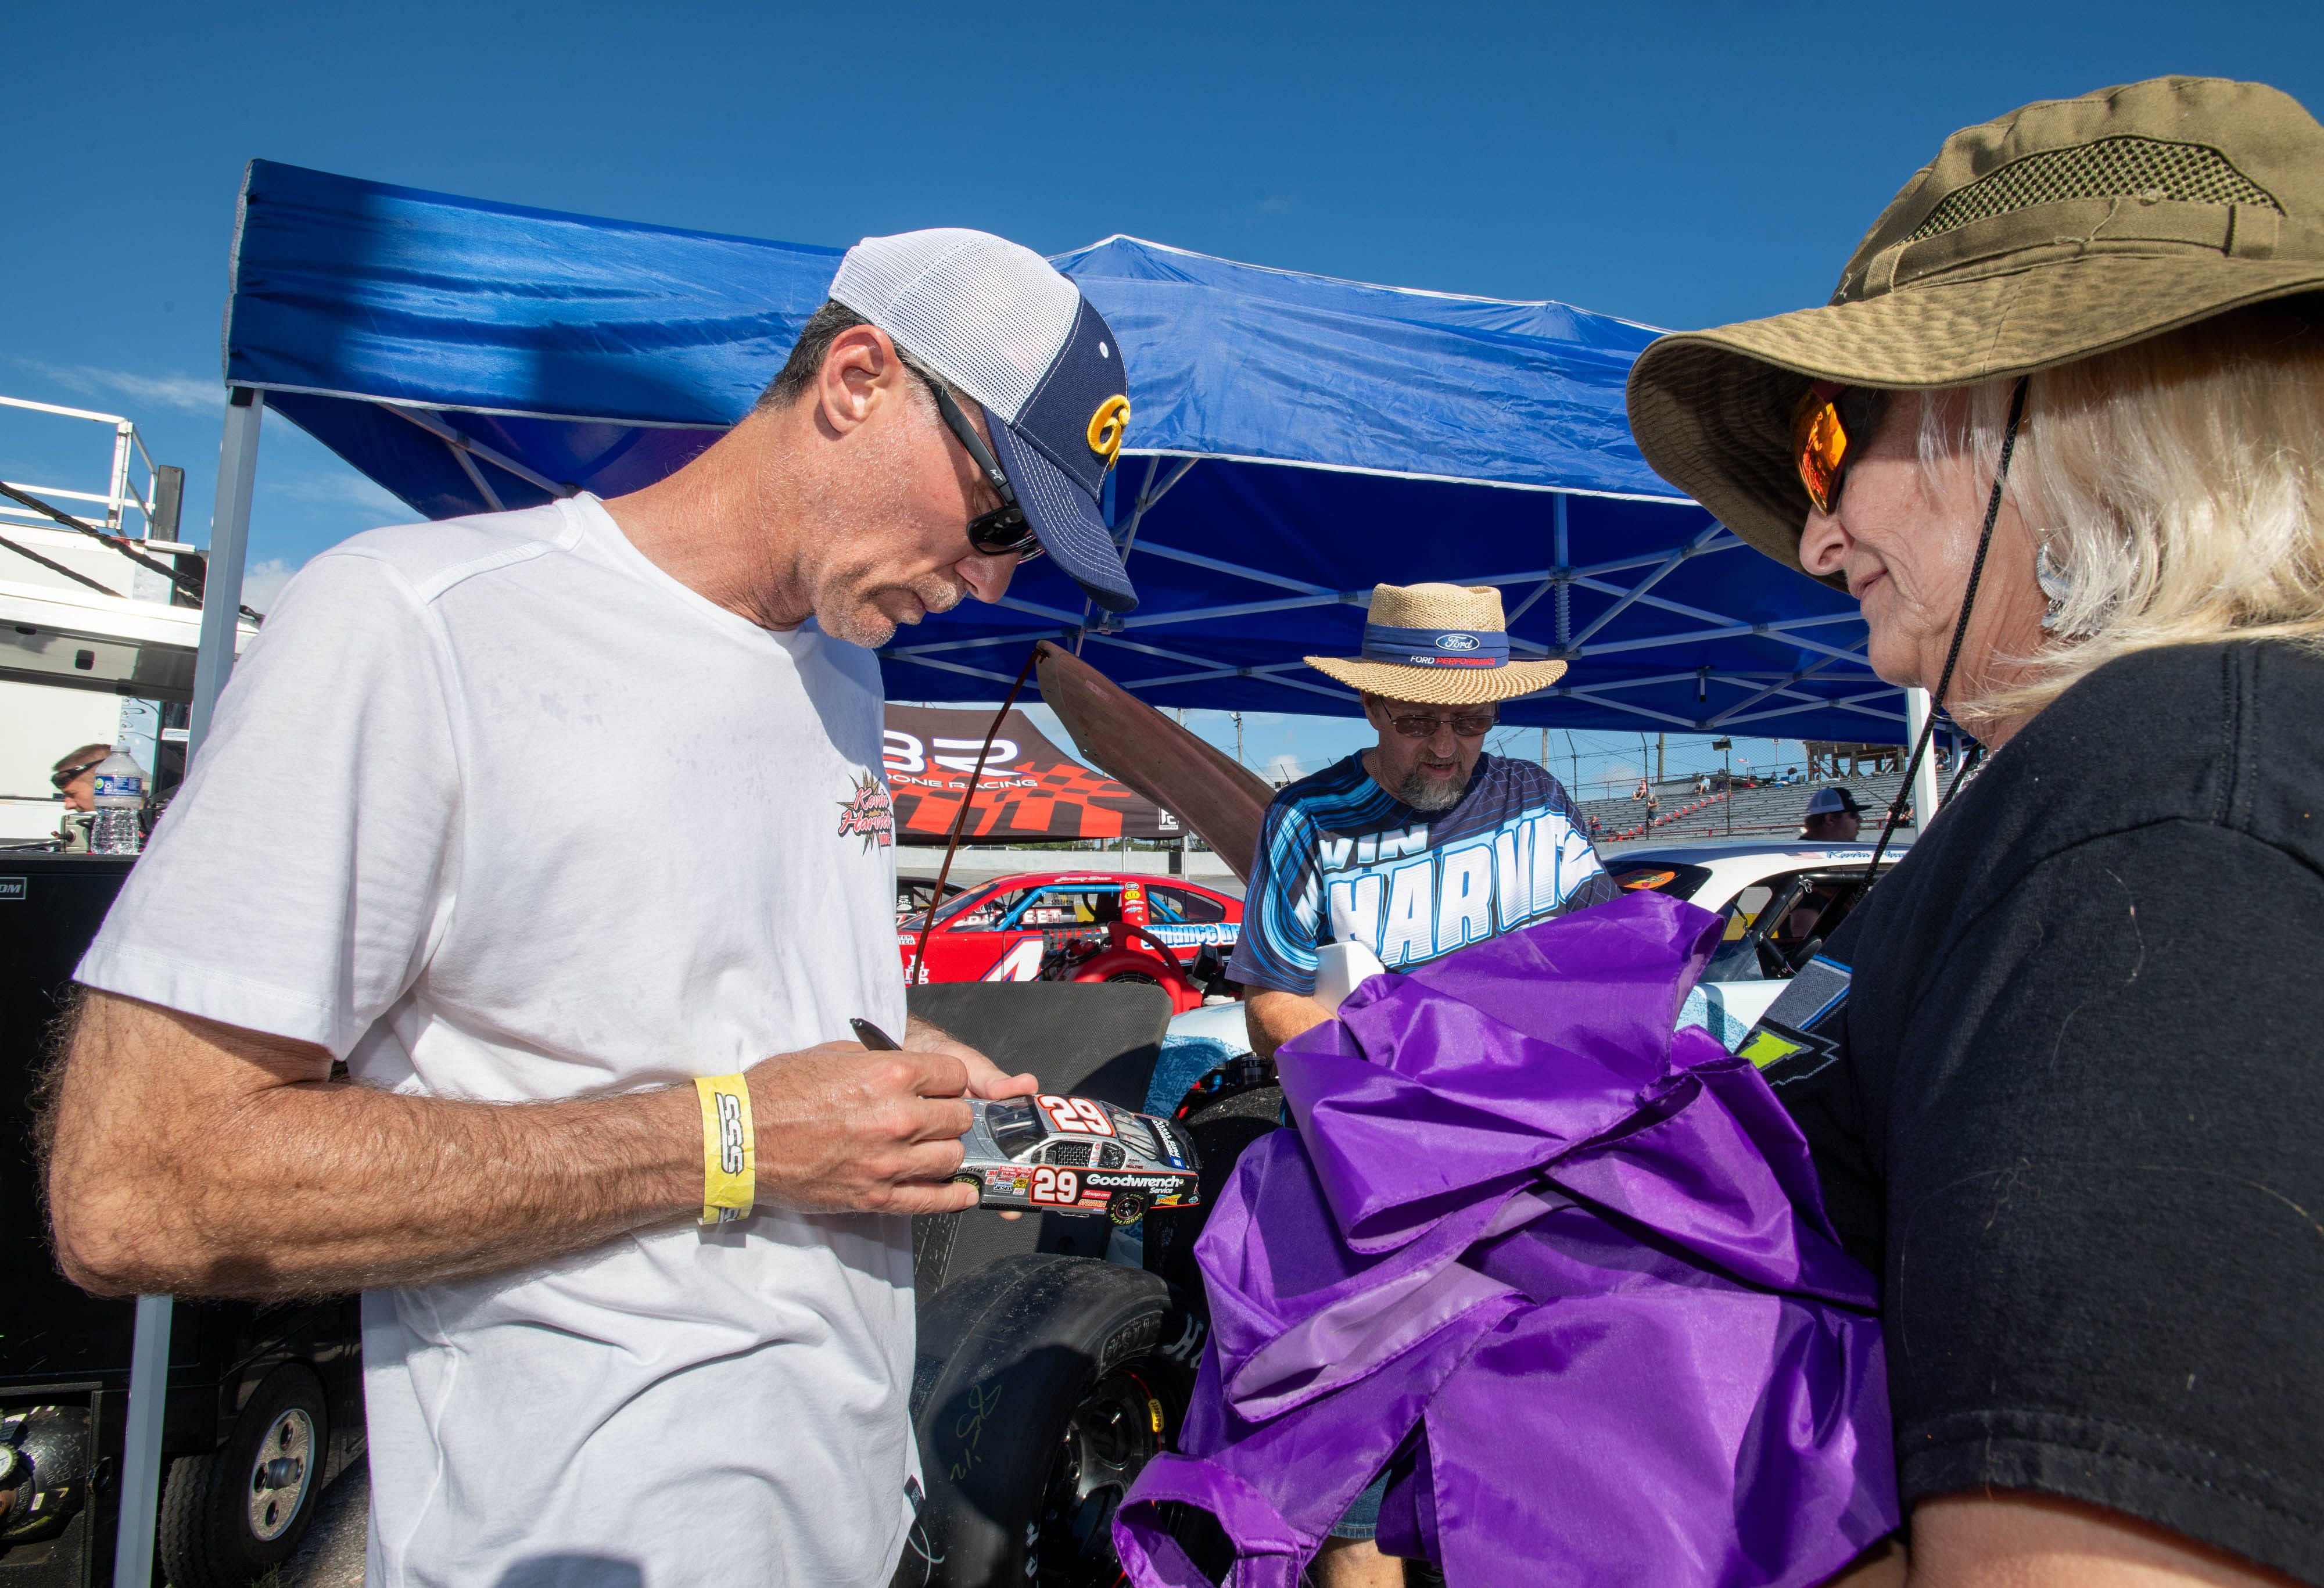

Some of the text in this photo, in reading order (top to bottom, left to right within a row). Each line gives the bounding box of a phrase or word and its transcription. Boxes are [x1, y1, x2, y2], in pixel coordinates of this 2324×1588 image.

[1445, 636, 1472, 648] Ford
[1410, 655, 1497, 666] FORD PERFORMANCE
[854, 788, 889, 810] Kevin
[1037, 1095, 1116, 1137] 29
[1032, 1167, 1078, 1204] 29
[1086, 1174, 1179, 1187] Goodwrench
